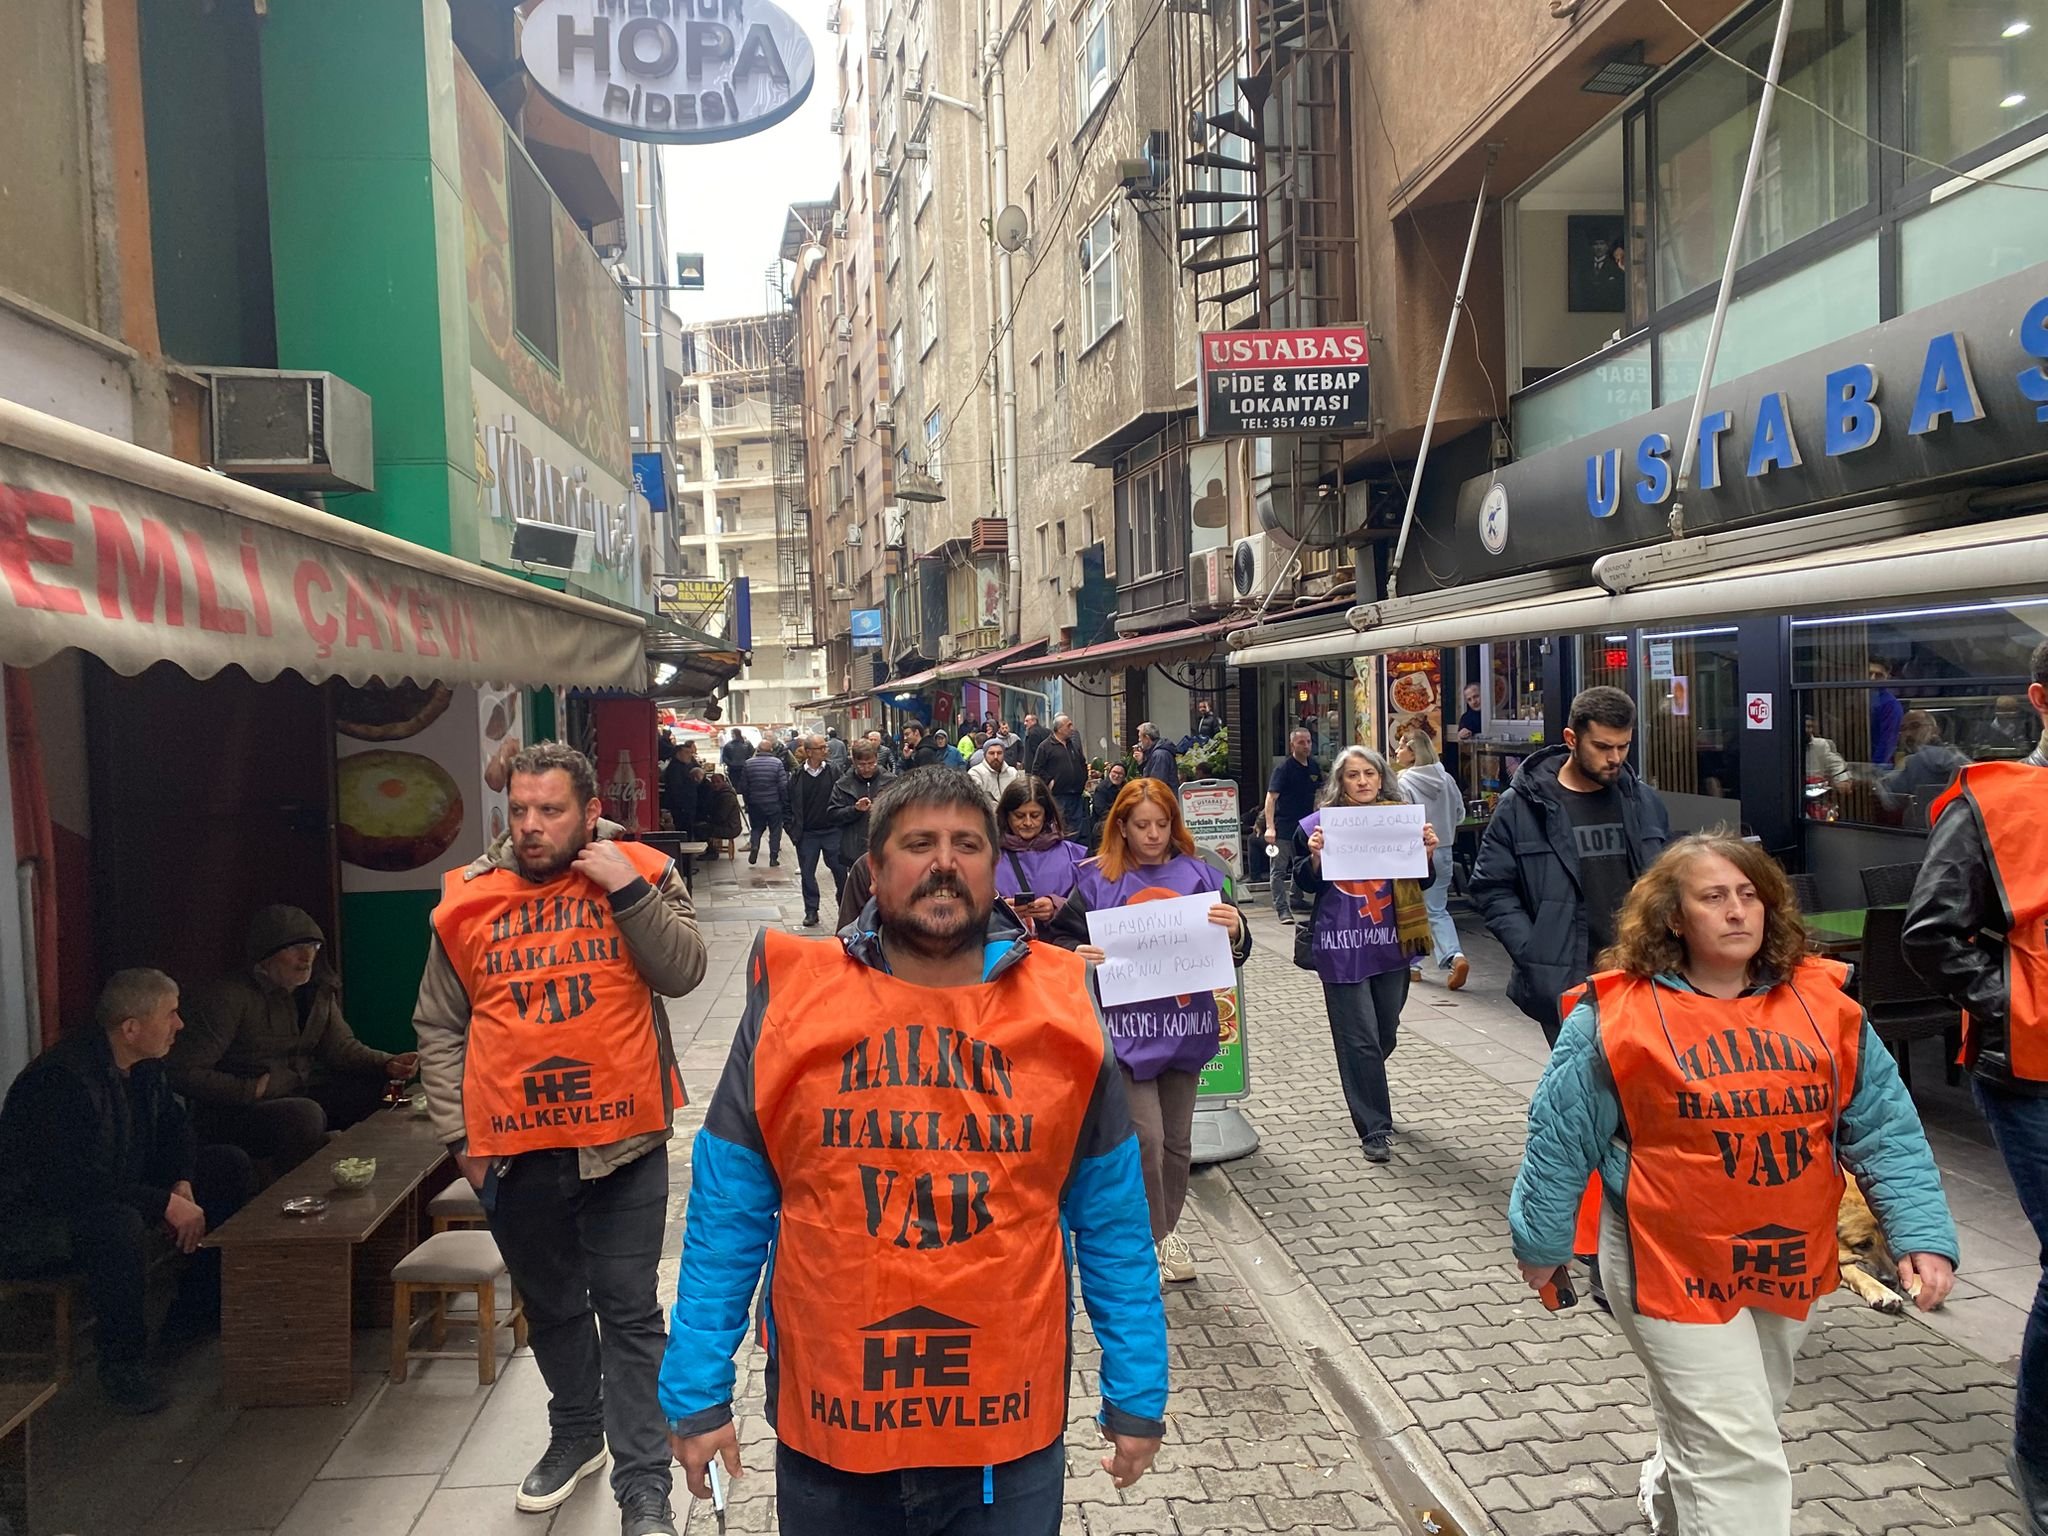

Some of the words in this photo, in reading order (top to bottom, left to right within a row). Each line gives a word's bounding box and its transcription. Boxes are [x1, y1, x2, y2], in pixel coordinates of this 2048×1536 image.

[556, 15, 791, 80] HOPA
[603, 82, 739, 124] PİDESİ
[1210, 335, 1364, 363] USTABAŞ
[1217, 372, 1265, 394] PİDE
[1272, 375, 1287, 392] &
[1294, 372, 1361, 392] KEBAP
[1229, 395, 1350, 415] LOKANTASI
[1241, 417, 1268, 430] TEL:
[1272, 416, 1295, 429] 351
[1300, 416, 1316, 428] 49
[1320, 415, 1336, 427] 57
[1186, 819, 1213, 827] Turkish
[1215, 817, 1237, 825] Foods
[491, 895, 605, 943] HALKIN
[485, 936, 622, 976] HAKLARI
[508, 973, 598, 1025] VAR
[1163, 1010, 1213, 1037] KADINLAR
[838, 1024, 1014, 1100] HALKIN
[1678, 1026, 1818, 1083] HALKIN
[491, 1093, 635, 1134] HALKEVLERİ
[1676, 1082, 1831, 1120] HAKLARI
[820, 1108, 1034, 1153] HAKLARI
[1712, 1126, 1815, 1187] VAR
[858, 1163, 995, 1250] VAR
[810, 1380, 1031, 1433] HALKEVLERİ
